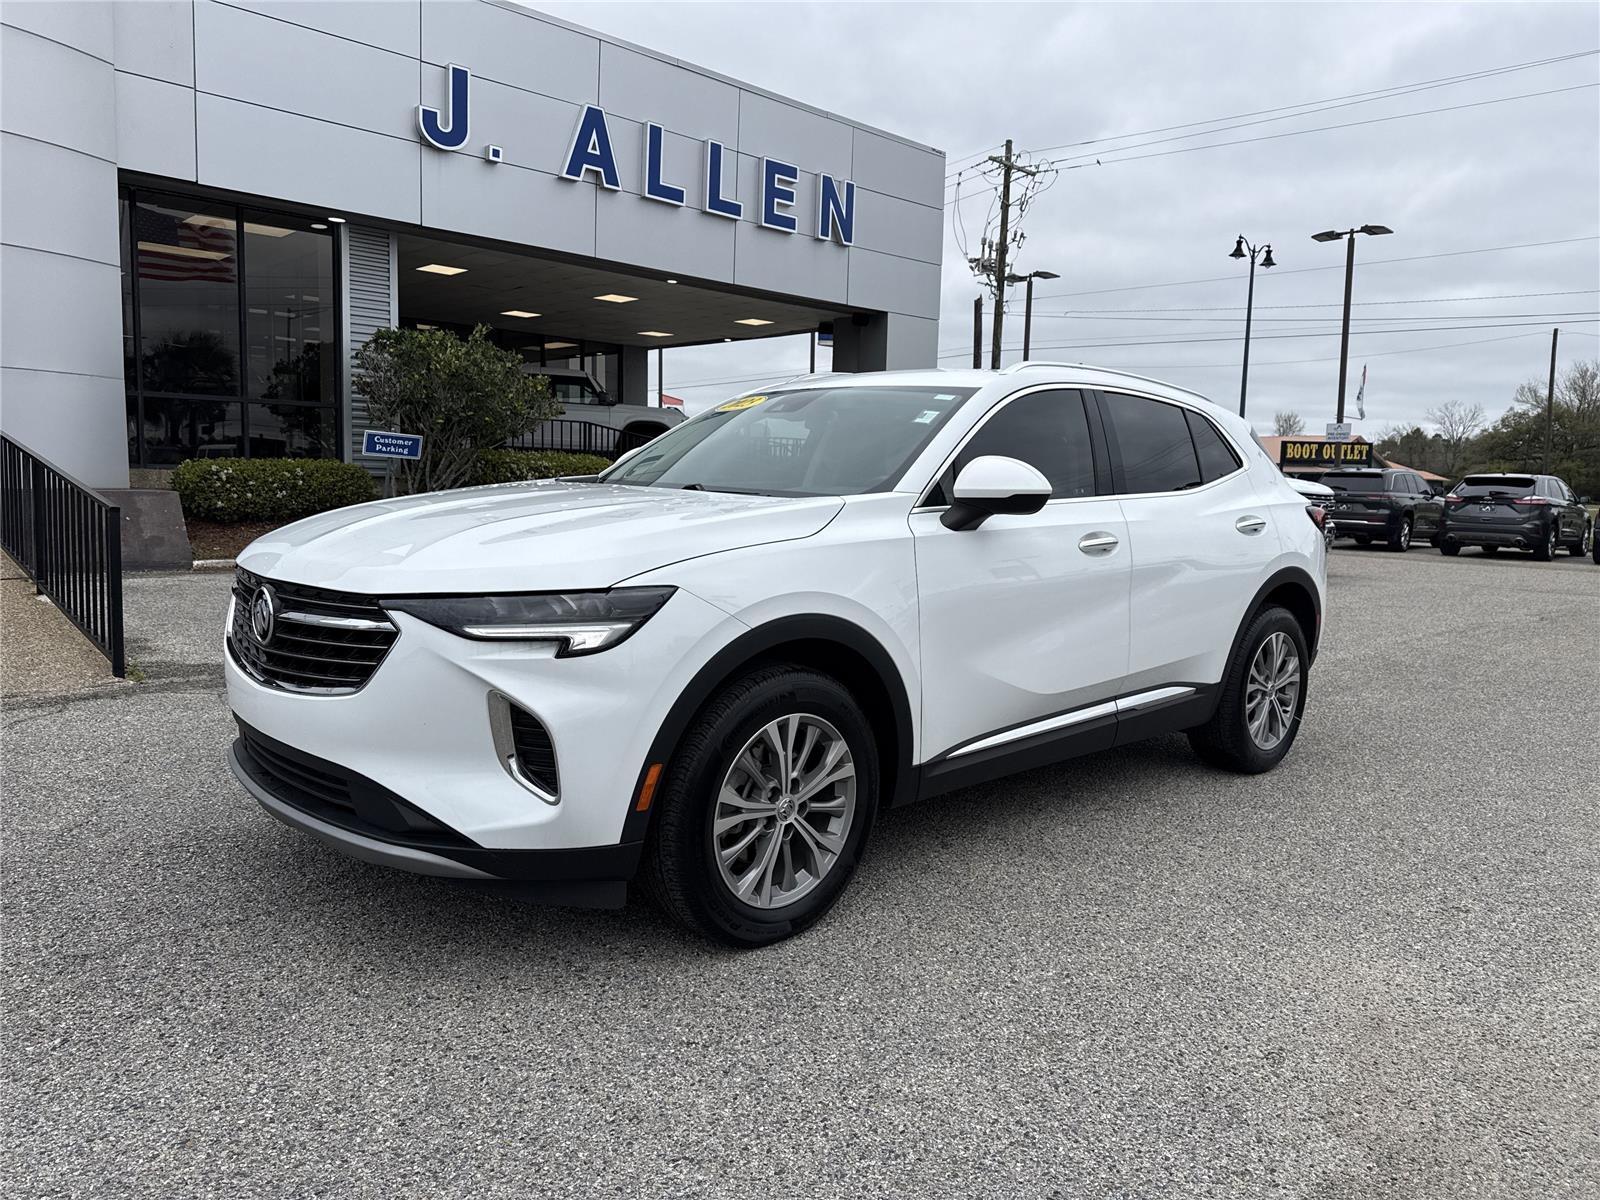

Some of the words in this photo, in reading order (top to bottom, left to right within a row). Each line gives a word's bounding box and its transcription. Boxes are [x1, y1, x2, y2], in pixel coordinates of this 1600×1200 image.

[416, 63, 503, 164] J.
[559, 103, 856, 246] ALLEN
[374, 435, 413, 445] Customer
[375, 444, 409, 454] Parking
[1286, 443, 1318, 459] BOOT
